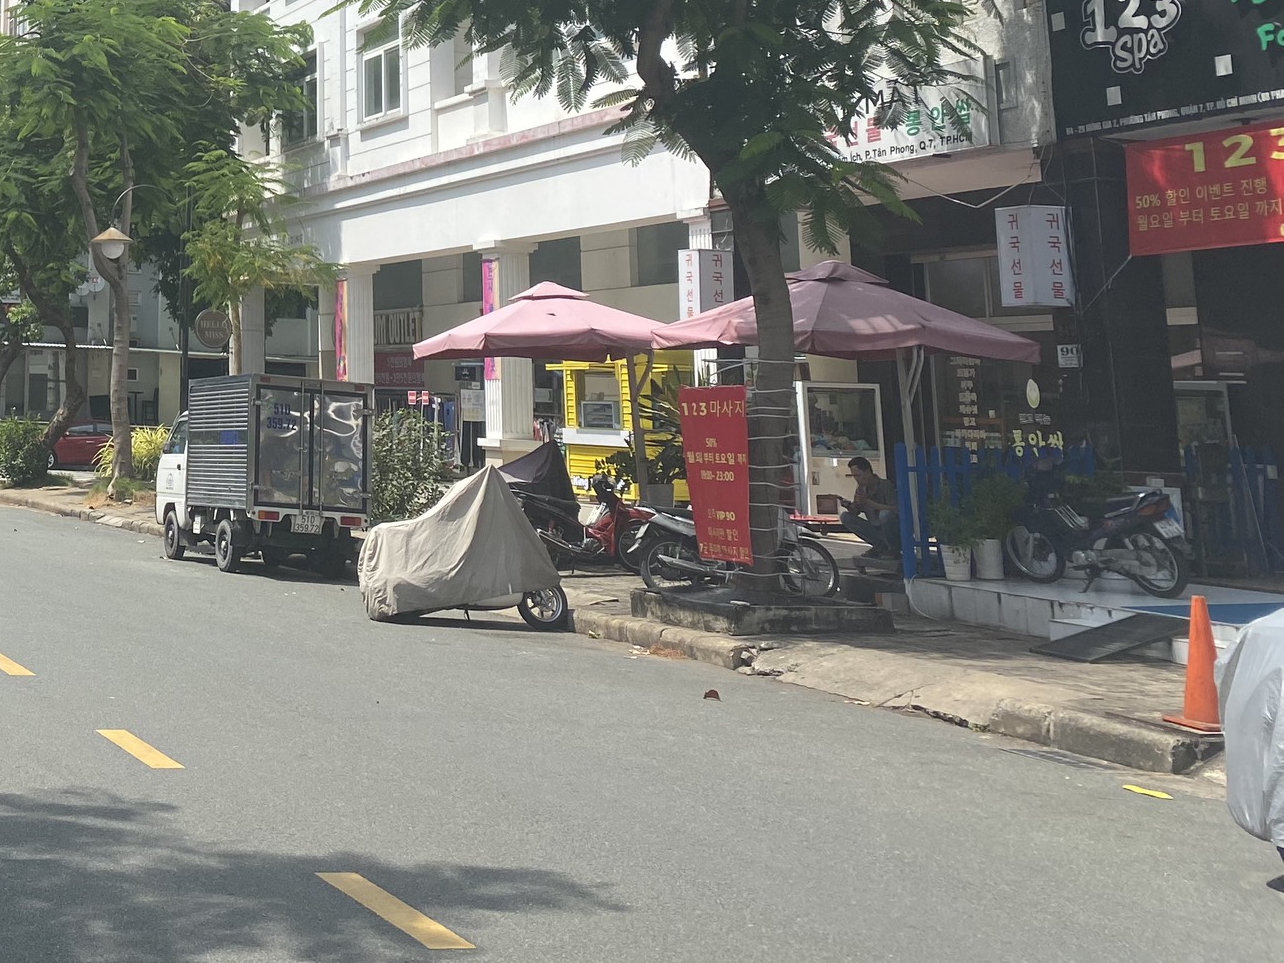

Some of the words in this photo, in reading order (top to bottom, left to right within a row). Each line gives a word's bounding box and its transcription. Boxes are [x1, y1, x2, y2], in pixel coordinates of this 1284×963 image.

[1136, 194, 1161, 209] 50%
[1166, 188, 1190, 206] 할인
[1196, 182, 1235, 202] 이벤트
[1241, 177, 1267, 196] 진행
[1137, 212, 1173, 231] 월요일
[1179, 208, 1204, 226] 부터
[1210, 202, 1249, 220] 토요일
[1256, 197, 1283, 217] 까지
[712, 254, 724, 303] 귀국선
[200, 320, 228, 328] HELLO
[388, 312, 420, 344] OUTLET
[1060, 347, 1077, 356] 90
[710, 400, 744, 417] 마사지
